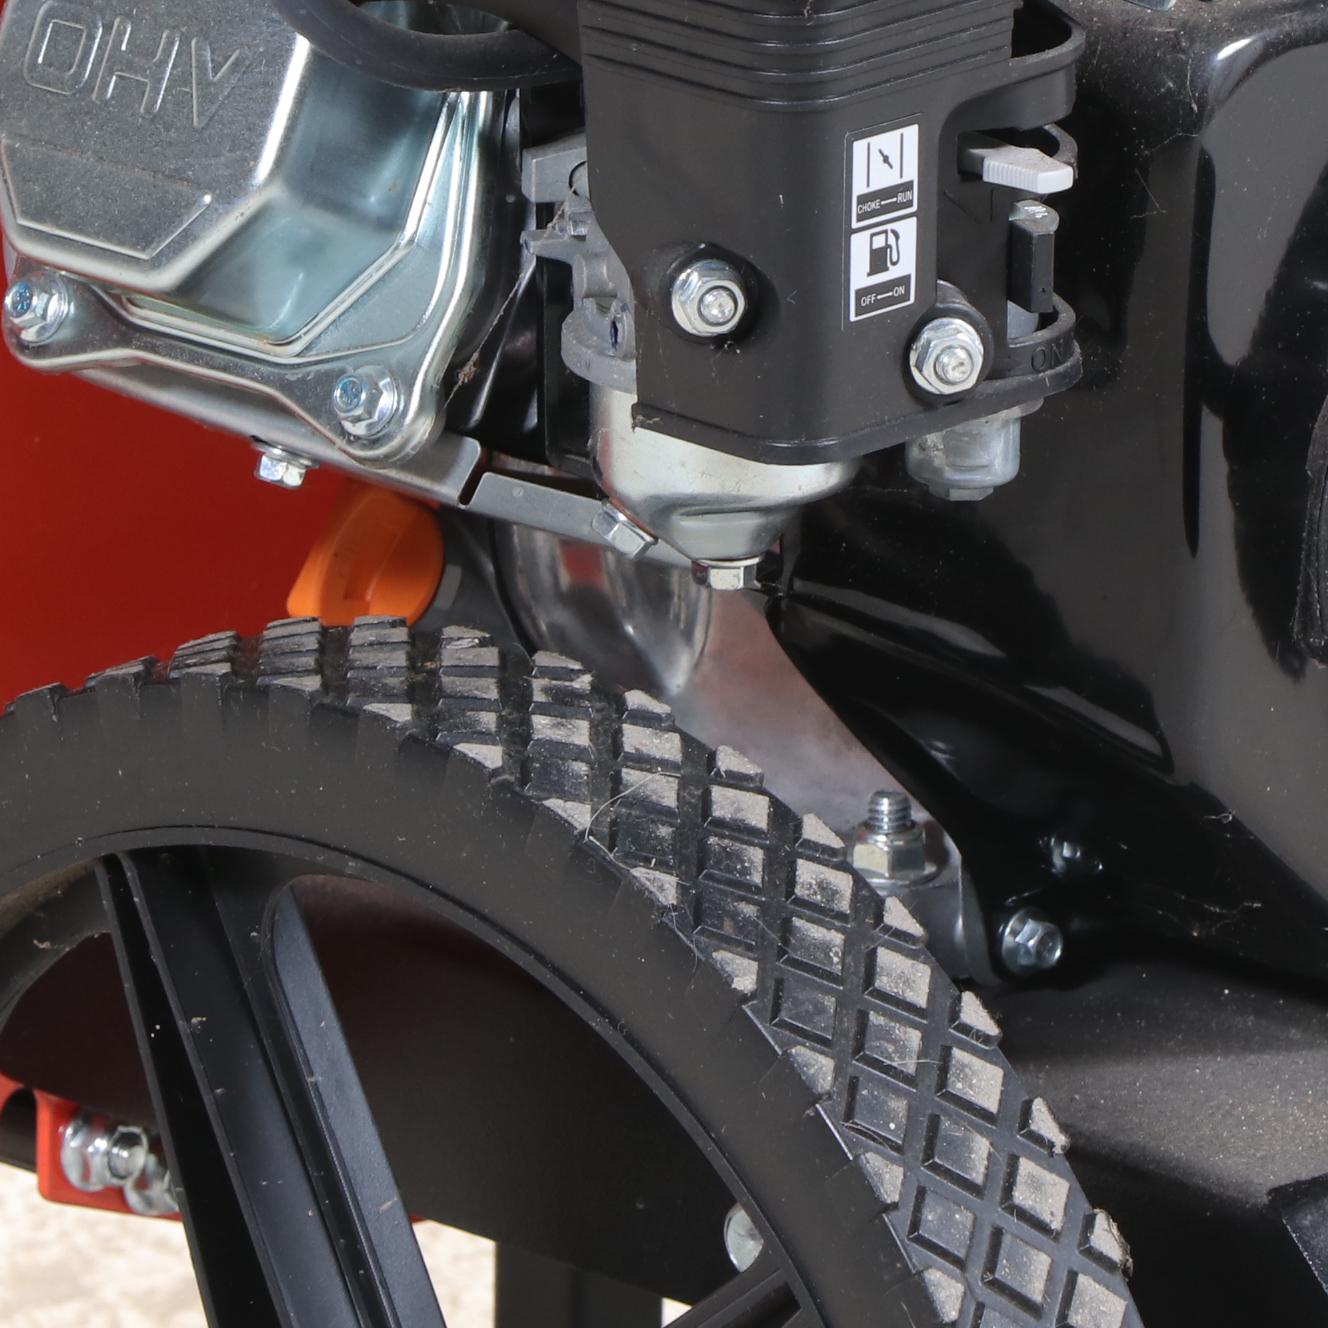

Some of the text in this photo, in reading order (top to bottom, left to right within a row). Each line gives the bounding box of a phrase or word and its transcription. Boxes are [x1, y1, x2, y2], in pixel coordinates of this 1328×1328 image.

[23, 0, 242, 129] OHV
[857, 189, 913, 215] CHOKE RUN
[860, 285, 905, 307] OFF ON
[1030, 338, 1065, 374] ON
